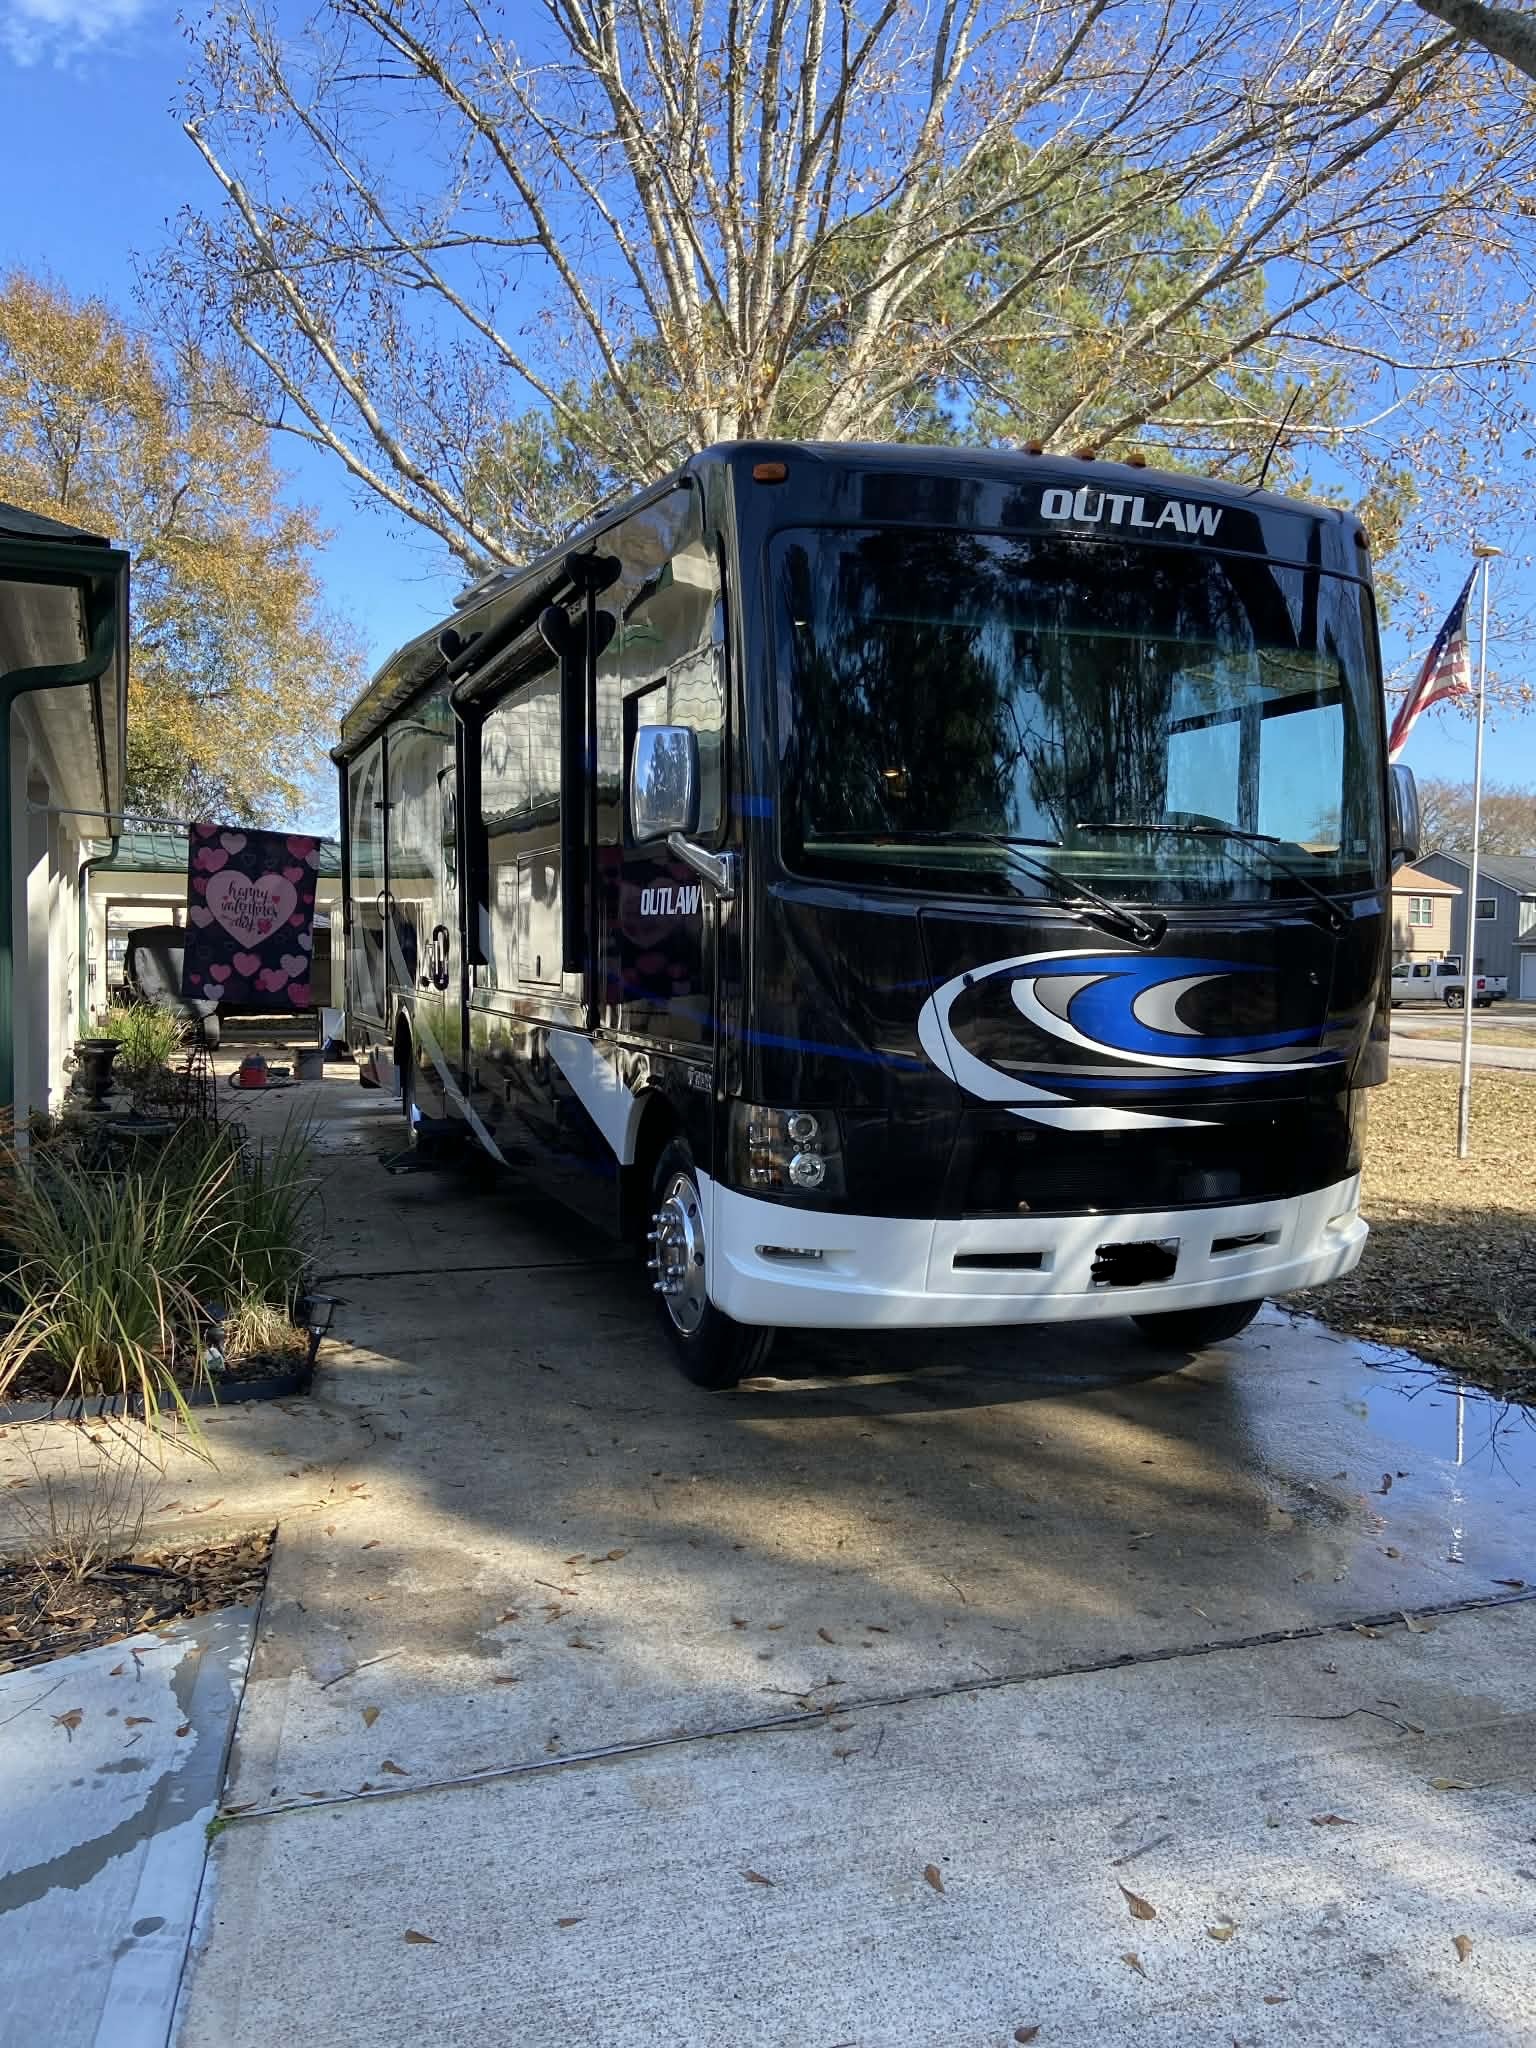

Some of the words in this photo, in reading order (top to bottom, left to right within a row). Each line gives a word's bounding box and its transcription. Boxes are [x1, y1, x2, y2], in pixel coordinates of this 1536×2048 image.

[1040, 489, 1223, 536] OUTLAW
[228, 880, 269, 902] happy
[640, 884, 700, 915] OUTLAW
[230, 911, 255, 932] day
